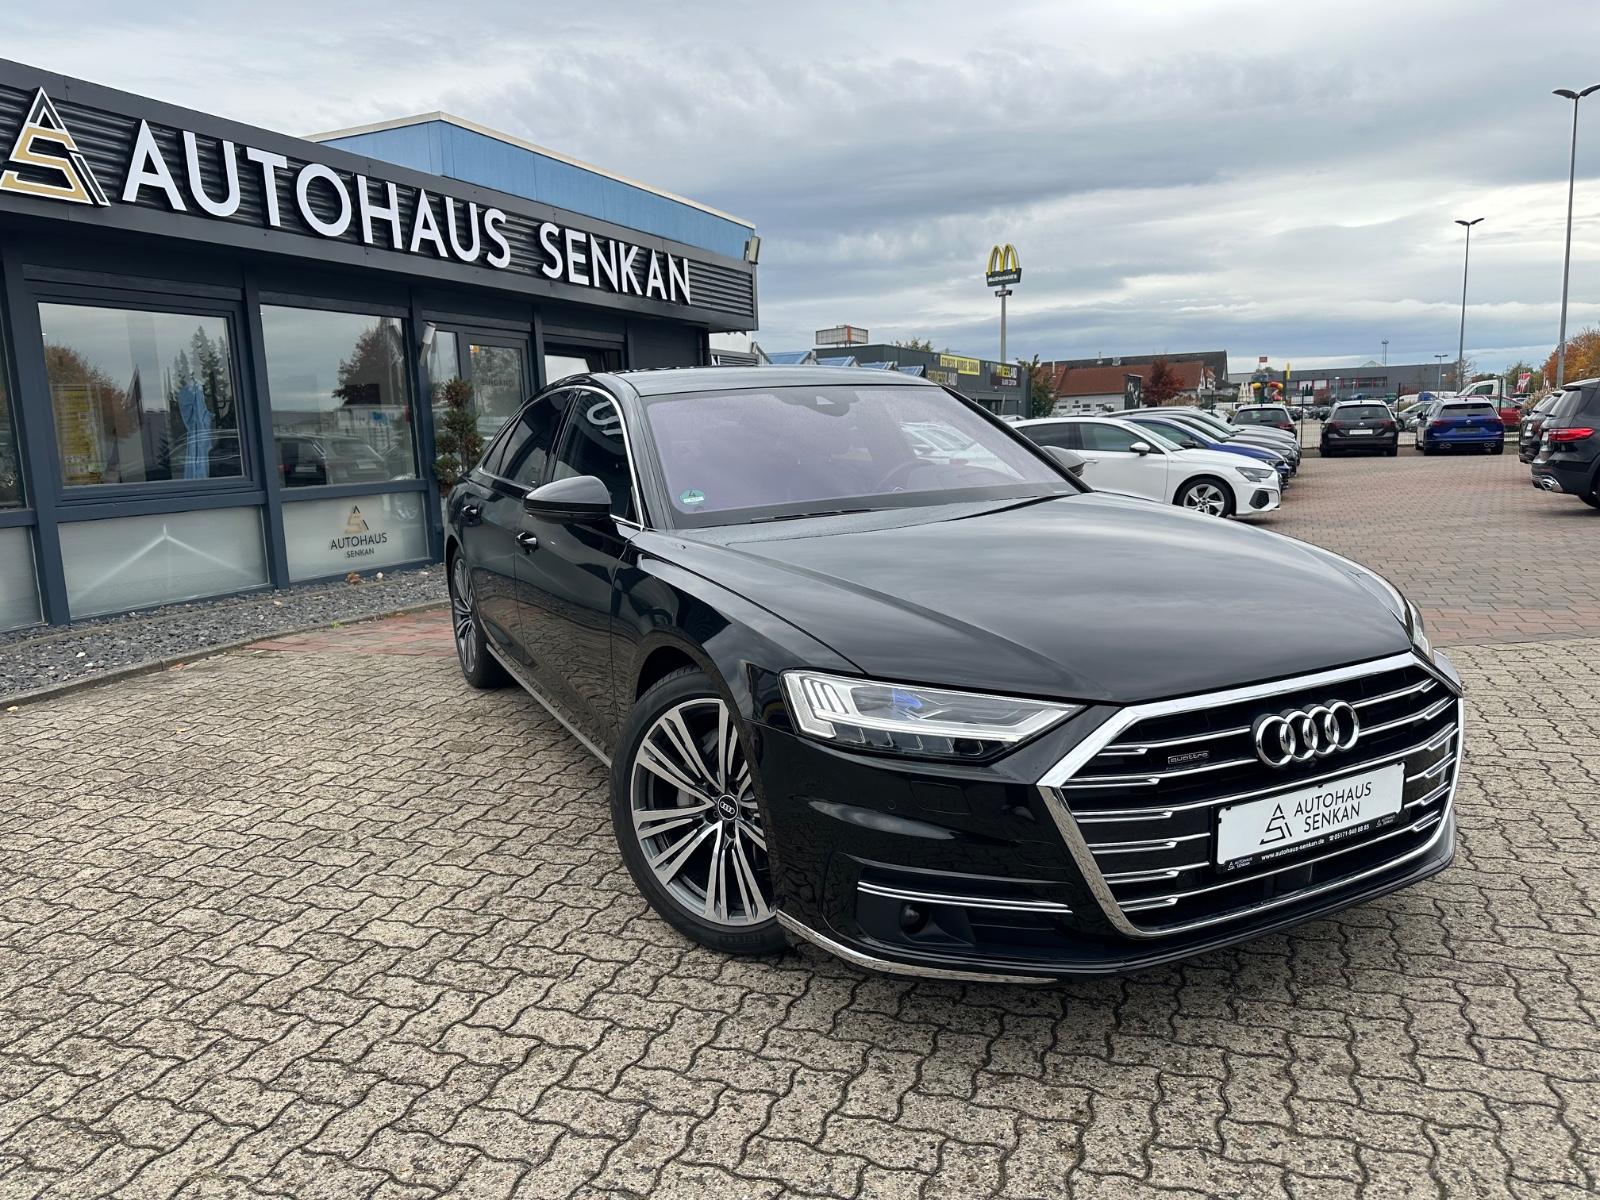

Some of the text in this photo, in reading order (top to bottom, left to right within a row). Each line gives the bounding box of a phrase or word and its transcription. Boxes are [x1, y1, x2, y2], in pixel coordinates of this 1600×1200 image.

[122, 118, 511, 269] AUTOHAUS
[540, 222, 691, 305] SENKAN
[330, 532, 388, 550] AUTOHAUS
[346, 547, 375, 559] SENKAN
[1170, 752, 1208, 763] quattro
[1294, 782, 1372, 817] AUTOHAUS
[1304, 802, 1360, 833] SENKAN
[1261, 838, 1325, 861] www.autohaus-senkan.de
